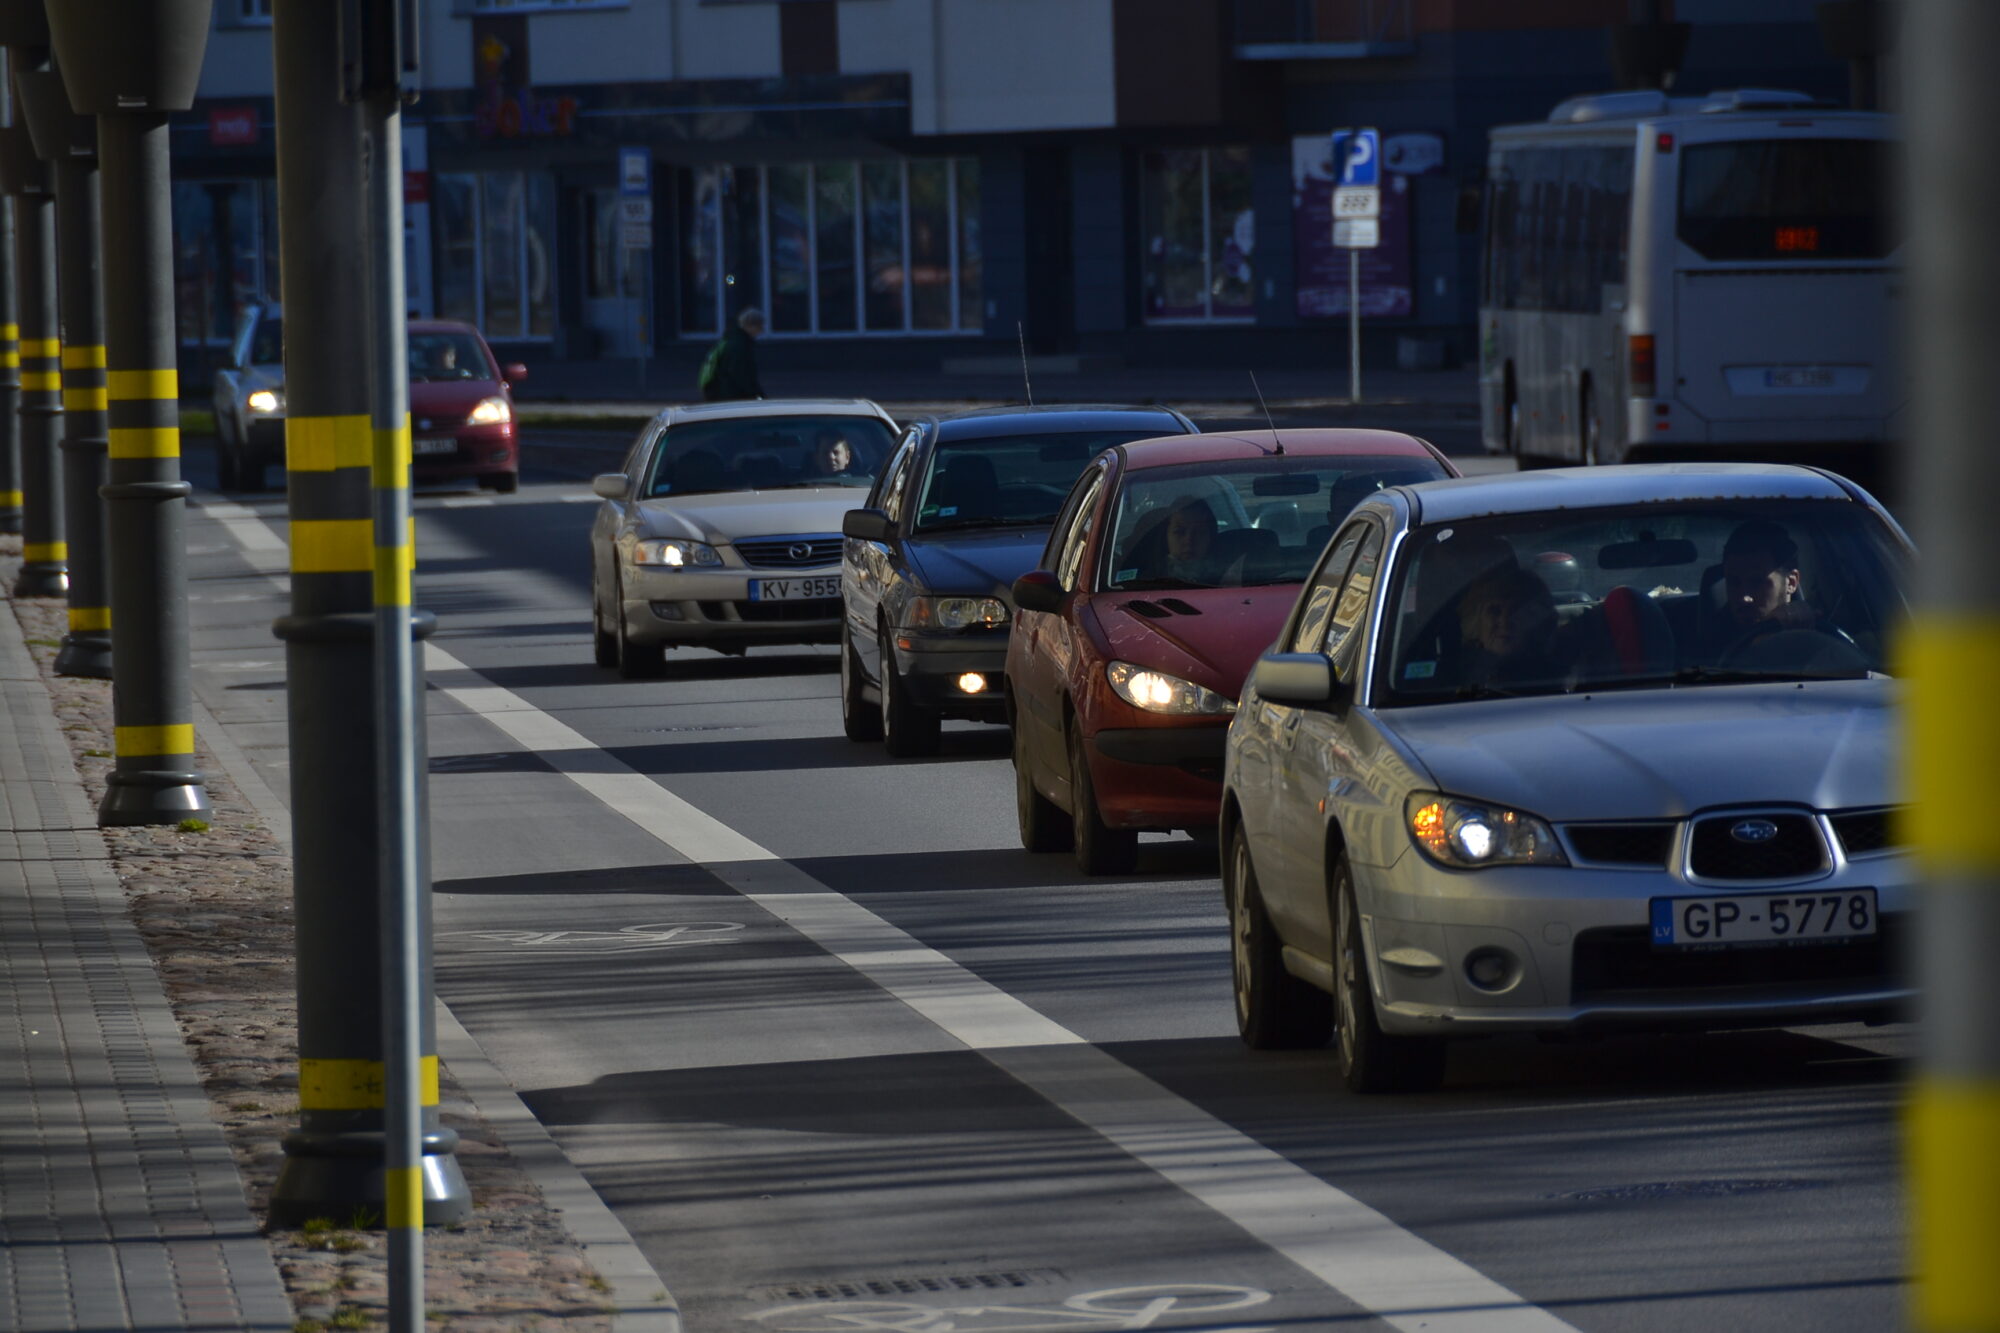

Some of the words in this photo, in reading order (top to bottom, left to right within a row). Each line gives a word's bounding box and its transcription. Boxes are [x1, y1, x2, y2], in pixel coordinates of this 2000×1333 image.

[1343, 135, 1373, 183] P
[763, 578, 842, 599] KV-955
[1655, 926, 1671, 937] LV
[1683, 895, 1869, 938] GP-5778
